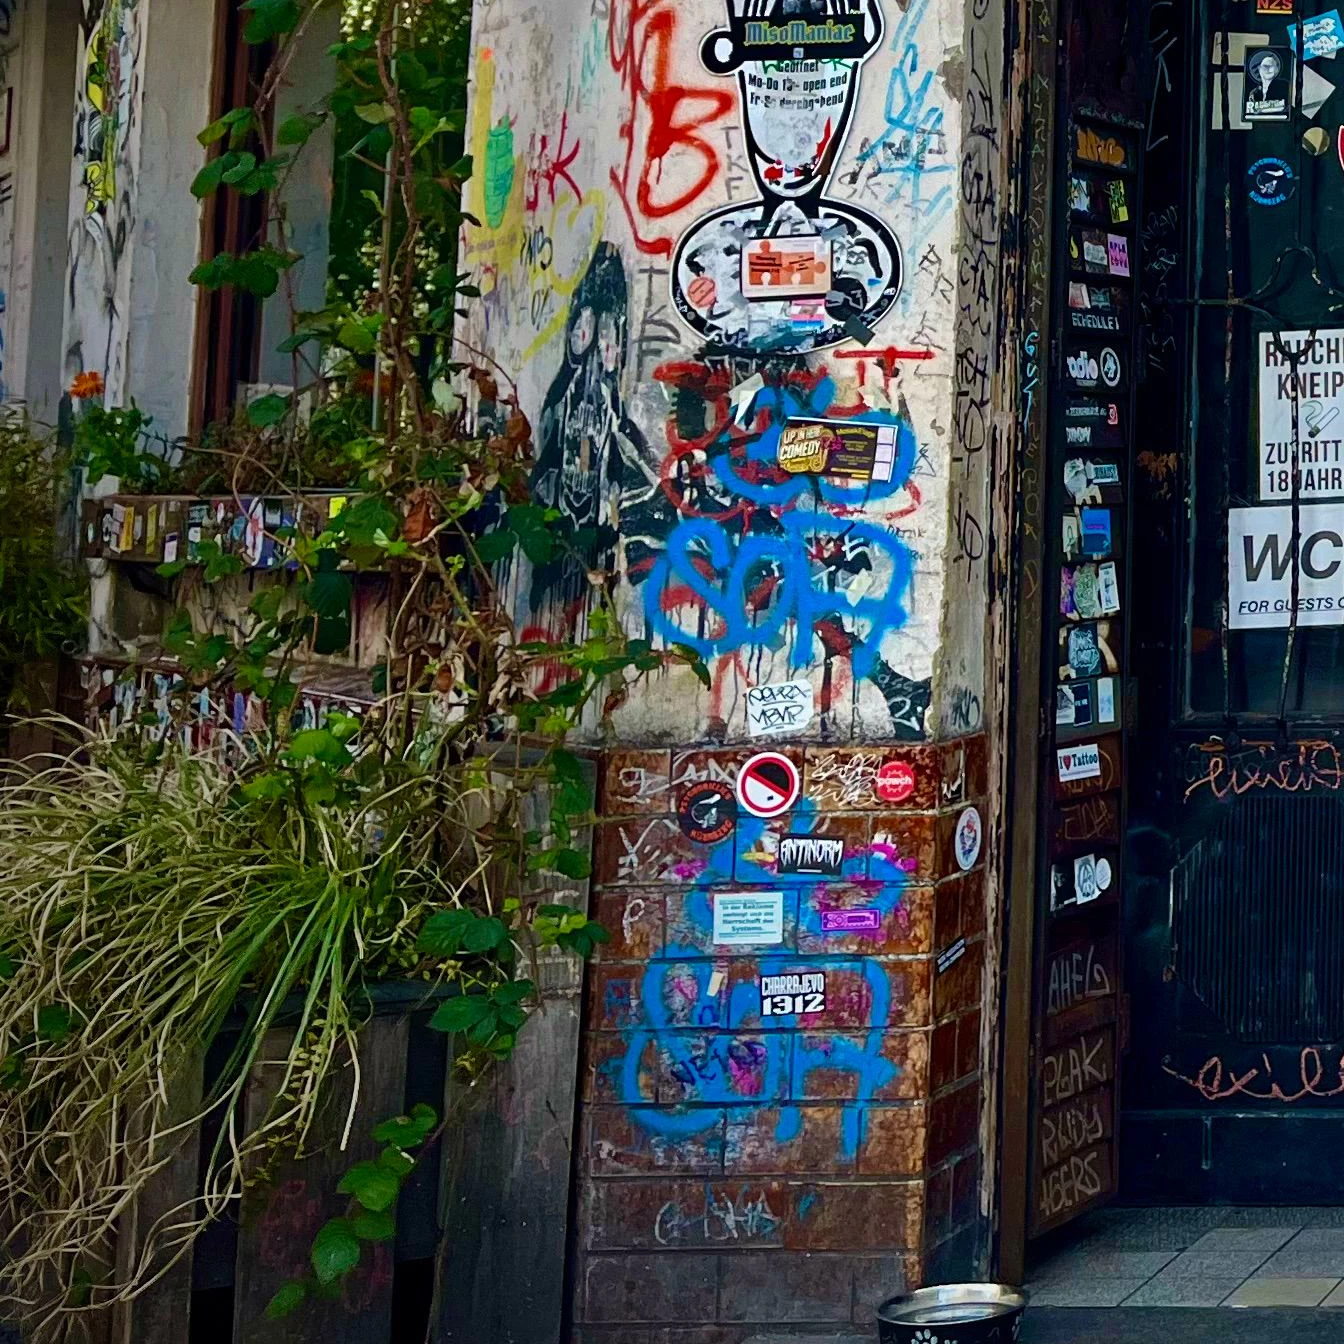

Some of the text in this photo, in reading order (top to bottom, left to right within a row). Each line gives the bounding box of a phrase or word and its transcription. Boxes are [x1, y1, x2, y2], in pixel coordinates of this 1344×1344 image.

[744, 19, 855, 46] MisoManiac
[803, 79, 827, 93] open
[829, 72, 847, 85] end
[780, 440, 821, 460] COMEDY
[1265, 439, 1342, 465] ZURITT
[1267, 470, 1288, 493] 18
[1243, 530, 1344, 583] WC
[1238, 600, 1269, 615] FOR
[1273, 596, 1335, 613] GUESTS
[1072, 753, 1099, 768] Tattoo
[780, 840, 844, 868] ANTINORM
[762, 993, 825, 1016] 1312
